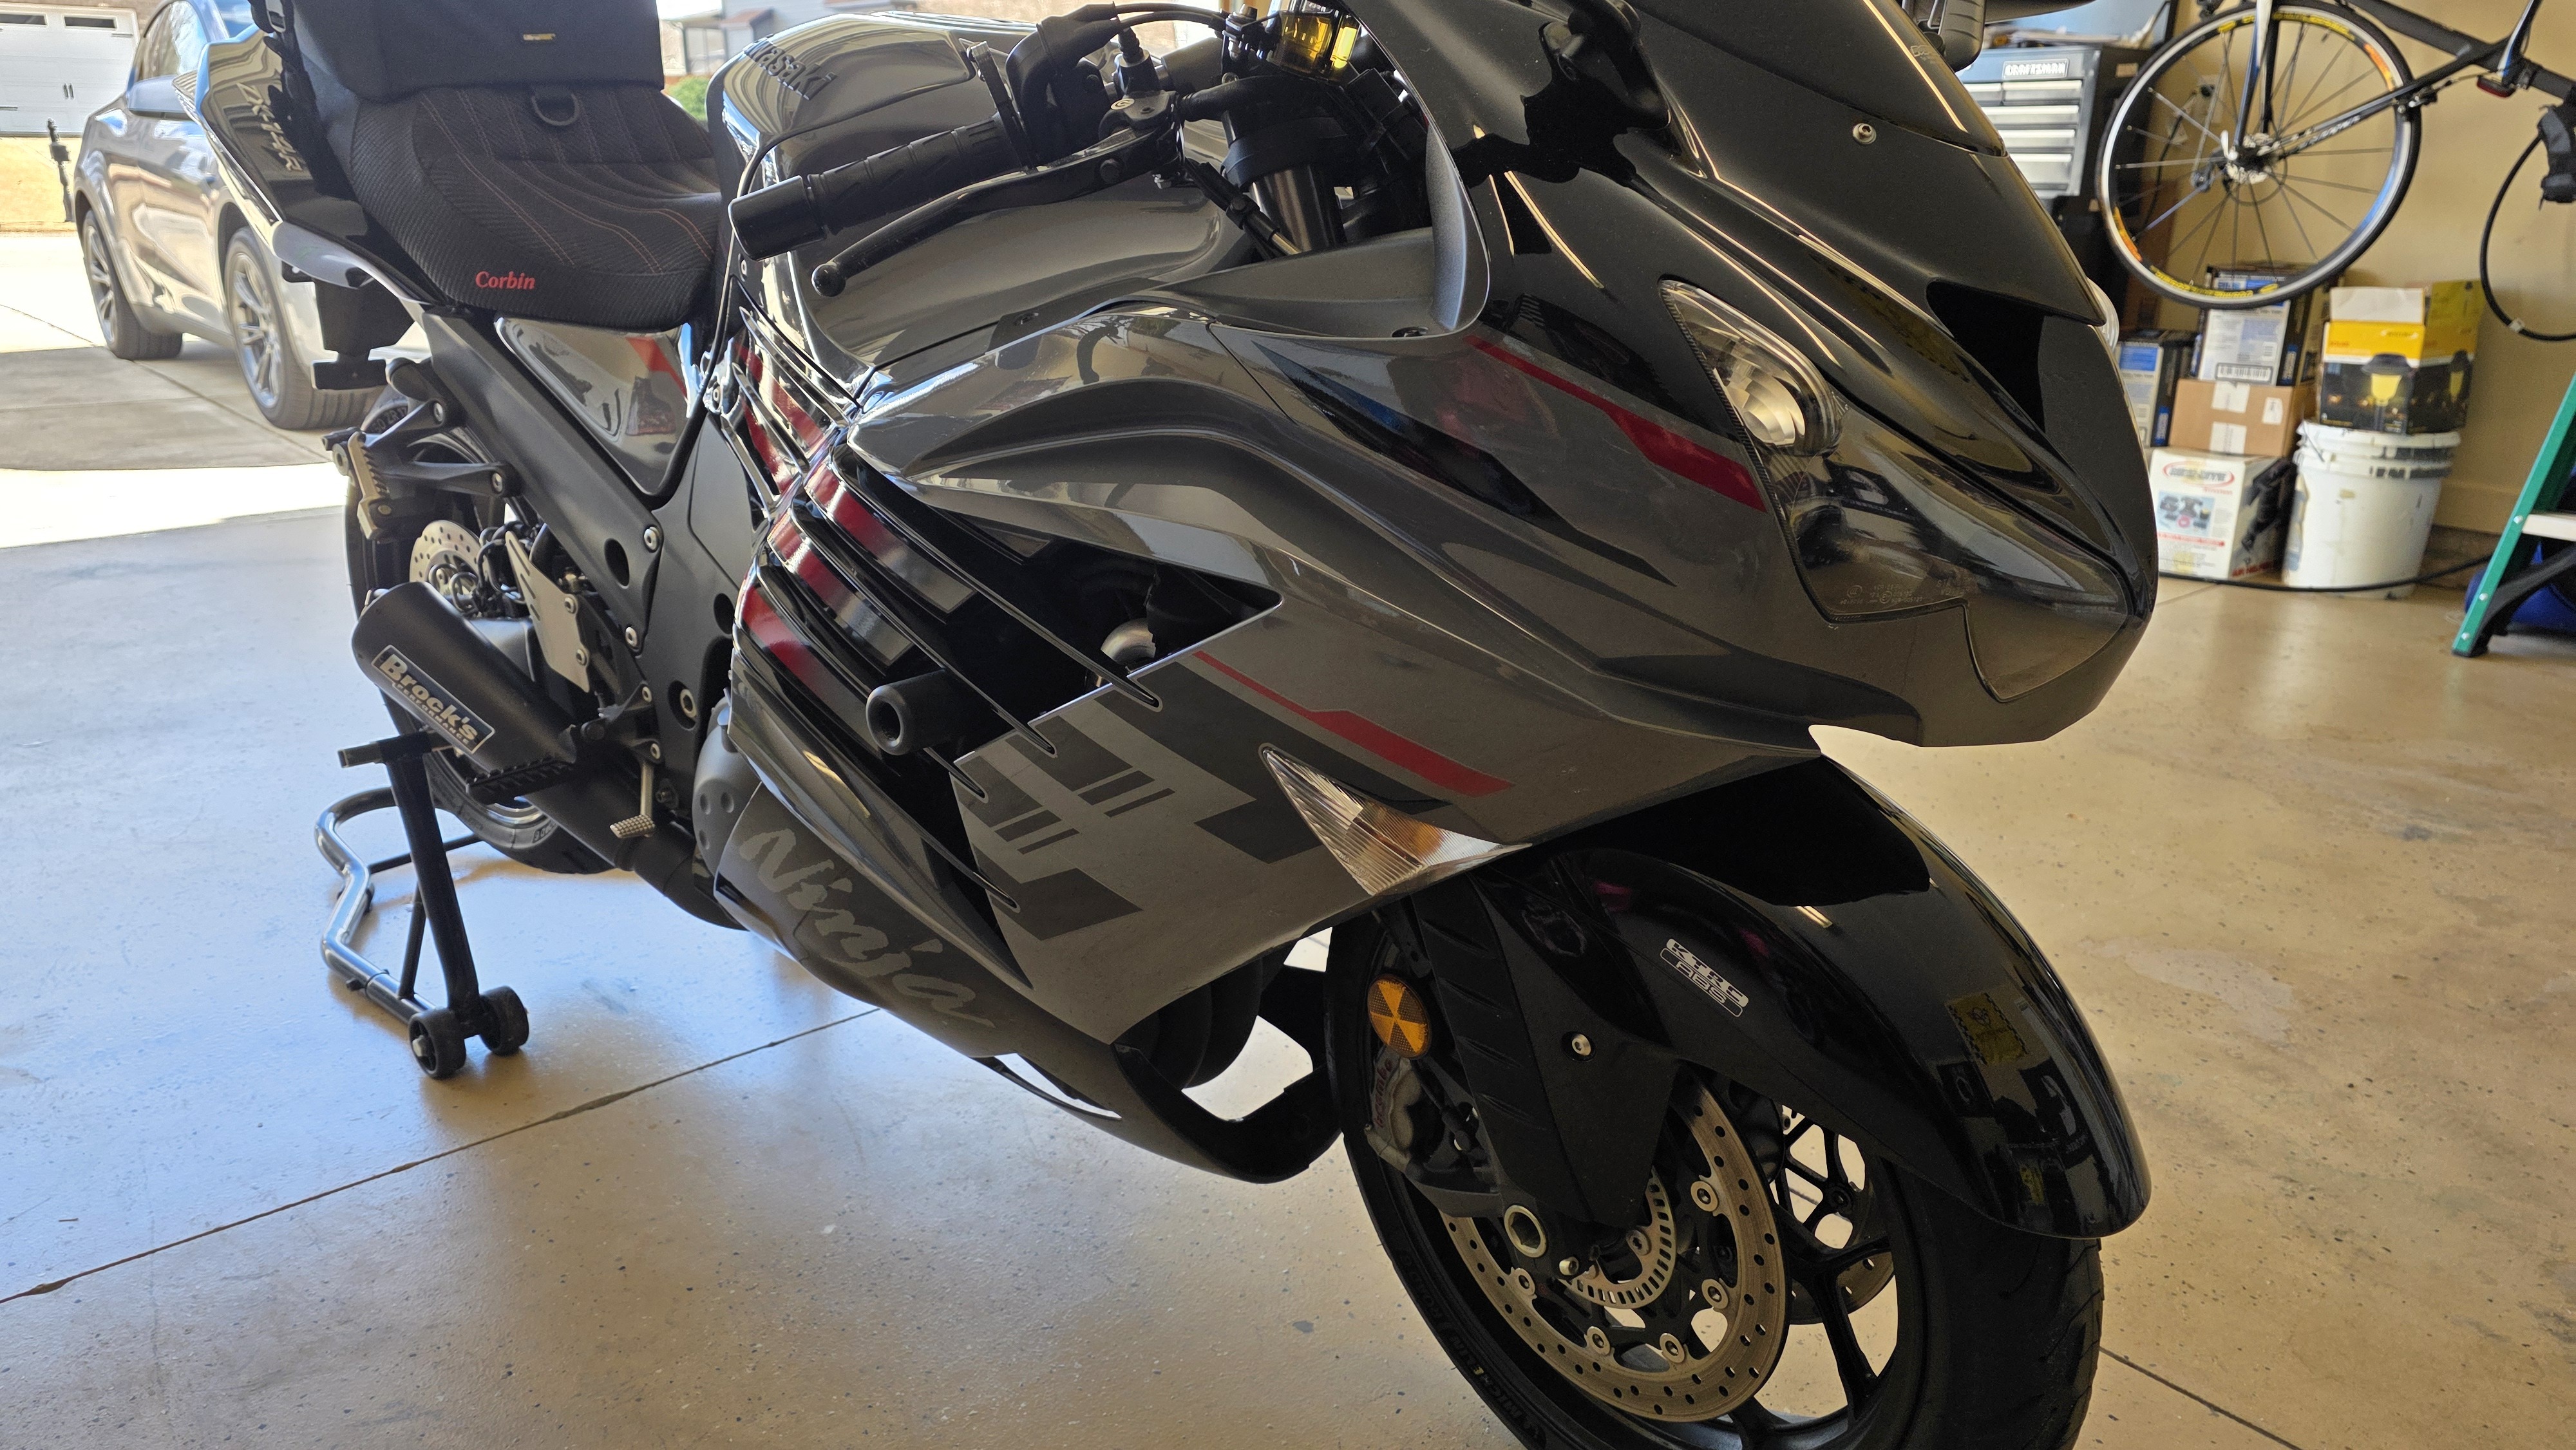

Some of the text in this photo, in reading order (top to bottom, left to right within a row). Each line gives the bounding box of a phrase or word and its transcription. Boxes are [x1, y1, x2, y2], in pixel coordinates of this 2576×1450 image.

[743, 34, 838, 100] wasaki
[2004, 62, 2066, 76] CRAFTSMAN
[236, 81, 304, 171] ZX-14R
[475, 270, 536, 290] Corbin
[379, 653, 479, 742] Brock's
[395, 683, 470, 746] PERFORMANCE
[739, 828, 996, 1028] Ninja
[1671, 942, 1744, 1003] KTRC
[1674, 959, 1728, 1004] ABS
[1449, 1333, 1523, 1418] MICHELIN
